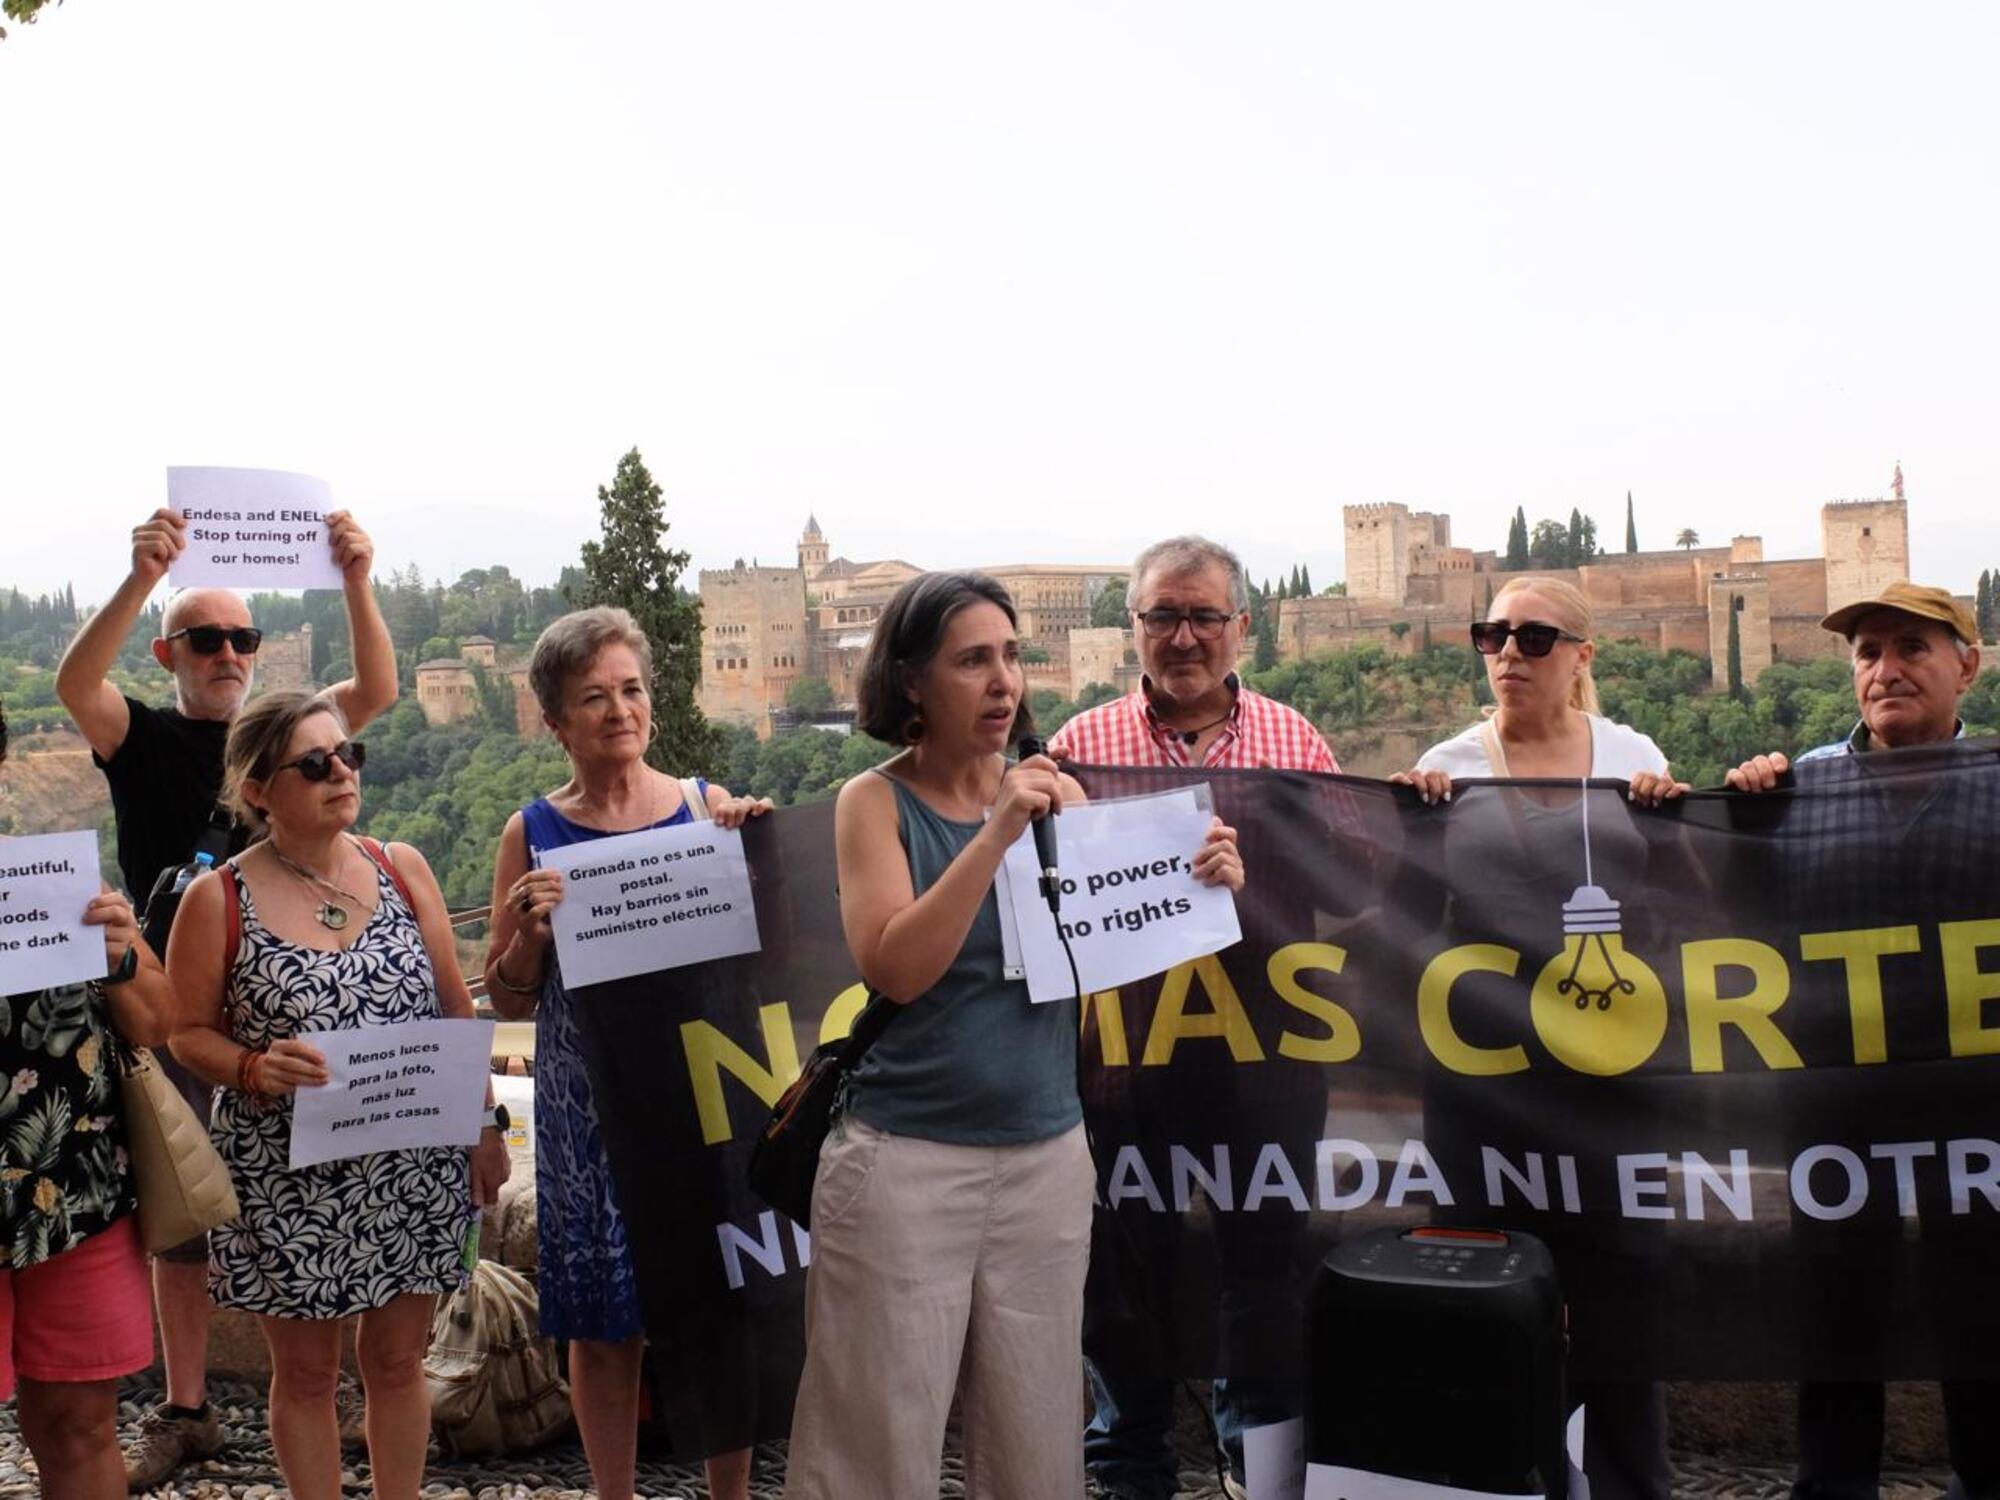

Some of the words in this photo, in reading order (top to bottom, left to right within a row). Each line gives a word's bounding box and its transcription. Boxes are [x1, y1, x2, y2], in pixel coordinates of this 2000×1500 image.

[182, 508, 242, 521] Endesa
[246, 510, 276, 522] and
[193, 529, 230, 544] Stop
[235, 530, 291, 544] turning
[296, 531, 318, 542] off
[211, 555, 238, 564] our
[242, 553, 300, 565] homes!
[569, 860, 636, 881] Granada
[640, 855, 660, 868] no
[664, 851, 682, 863] es
[687, 844, 716, 858] una
[619, 872, 673, 894] postal.
[1087, 854, 1192, 896] power,
[591, 904, 622, 918] Hay
[626, 893, 682, 911] barrios
[686, 885, 709, 899] sin
[0, 908, 50, 925] oods
[1058, 920, 1092, 940] no
[1102, 897, 1192, 933] rights
[27, 932, 71, 948] dark
[575, 917, 659, 942] suministro
[349, 1050, 396, 1066] Menos
[400, 1043, 440, 1056] luces
[348, 1074, 381, 1090] para
[385, 1069, 398, 1080] la
[402, 1064, 435, 1077] foto,
[395, 1087, 417, 1098] luz
[331, 1117, 366, 1132] para
[370, 1111, 391, 1124] las
[395, 1107, 440, 1119] casas
[1096, 1138, 1455, 1213] ANADA
[1481, 1146, 1582, 1213] NI
[1617, 1149, 1755, 1222] EN
[1789, 1137, 2000, 1221] OTR
